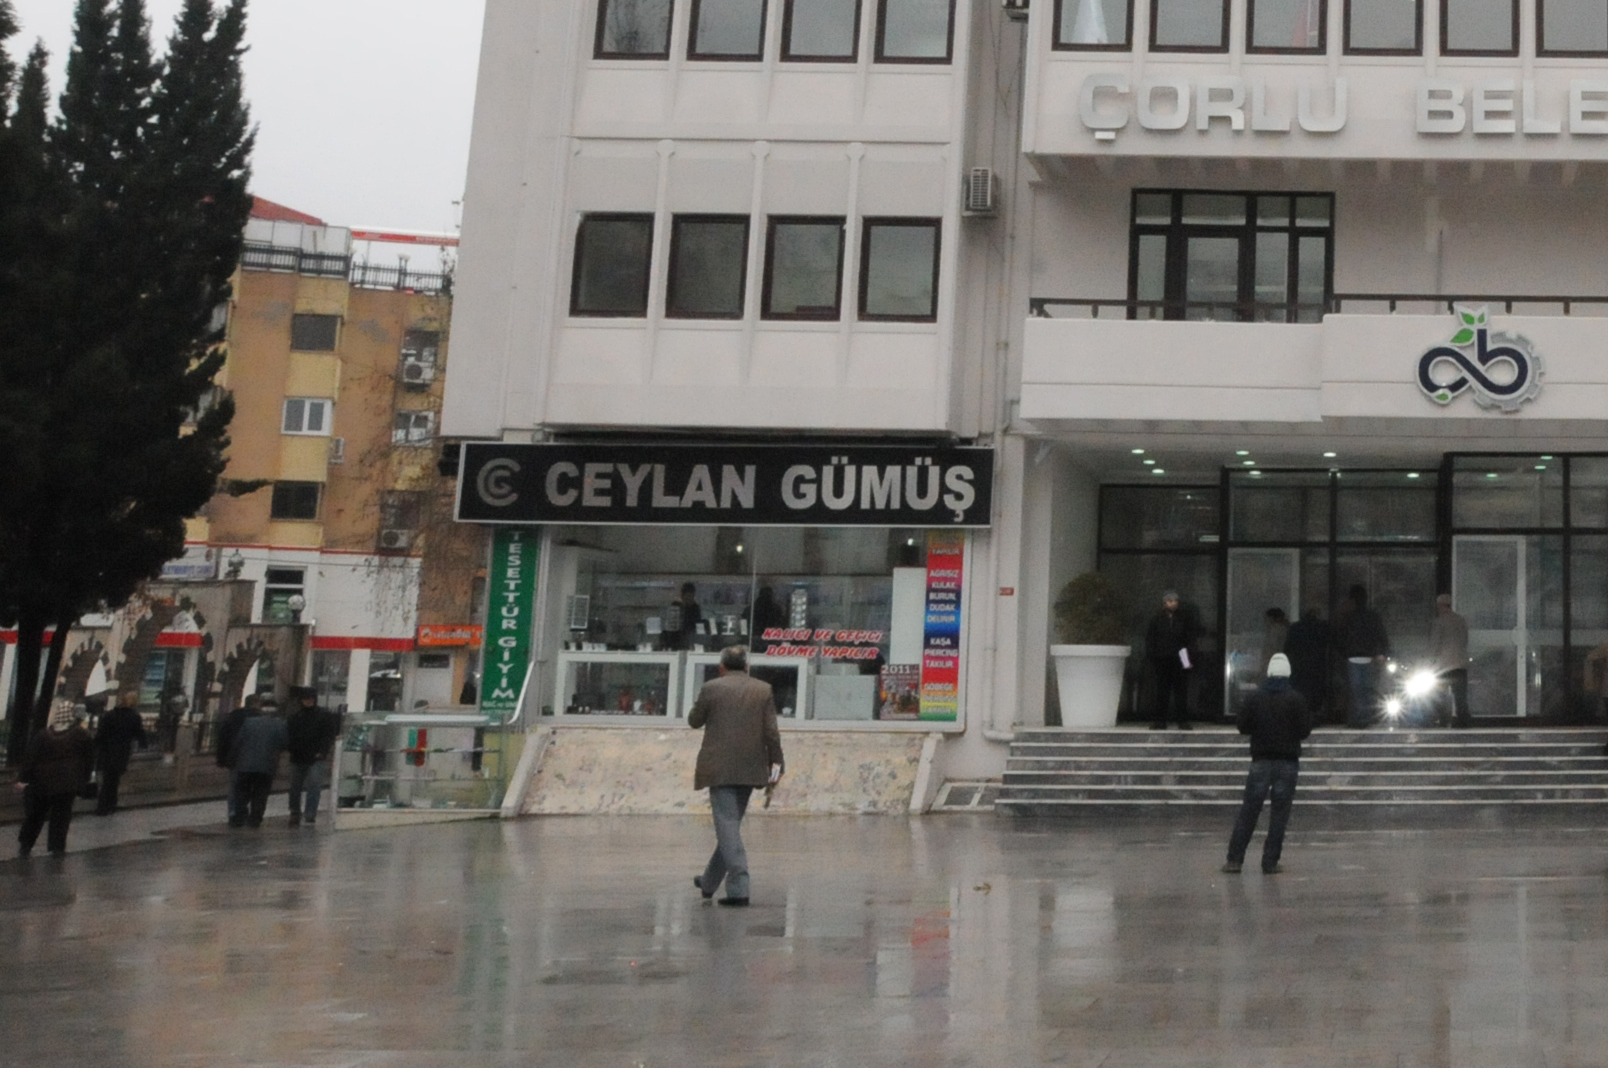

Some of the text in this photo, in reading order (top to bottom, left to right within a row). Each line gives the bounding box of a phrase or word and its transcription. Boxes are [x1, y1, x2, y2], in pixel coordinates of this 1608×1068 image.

[1079, 72, 1348, 140] ÇORLU
[545, 461, 757, 509] CEYLAN
[780, 455, 976, 523] GÜMÜŞ
[501, 532, 522, 630] TESETTÜR
[762, 628, 812, 641] KALICI
[813, 629, 833, 641] VE
[765, 643, 880, 659] DÖVME YAPILIR
[930, 637, 952, 647] KAŞA
[491, 636, 518, 699] GİYİM
[881, 664, 911, 674] 2011
